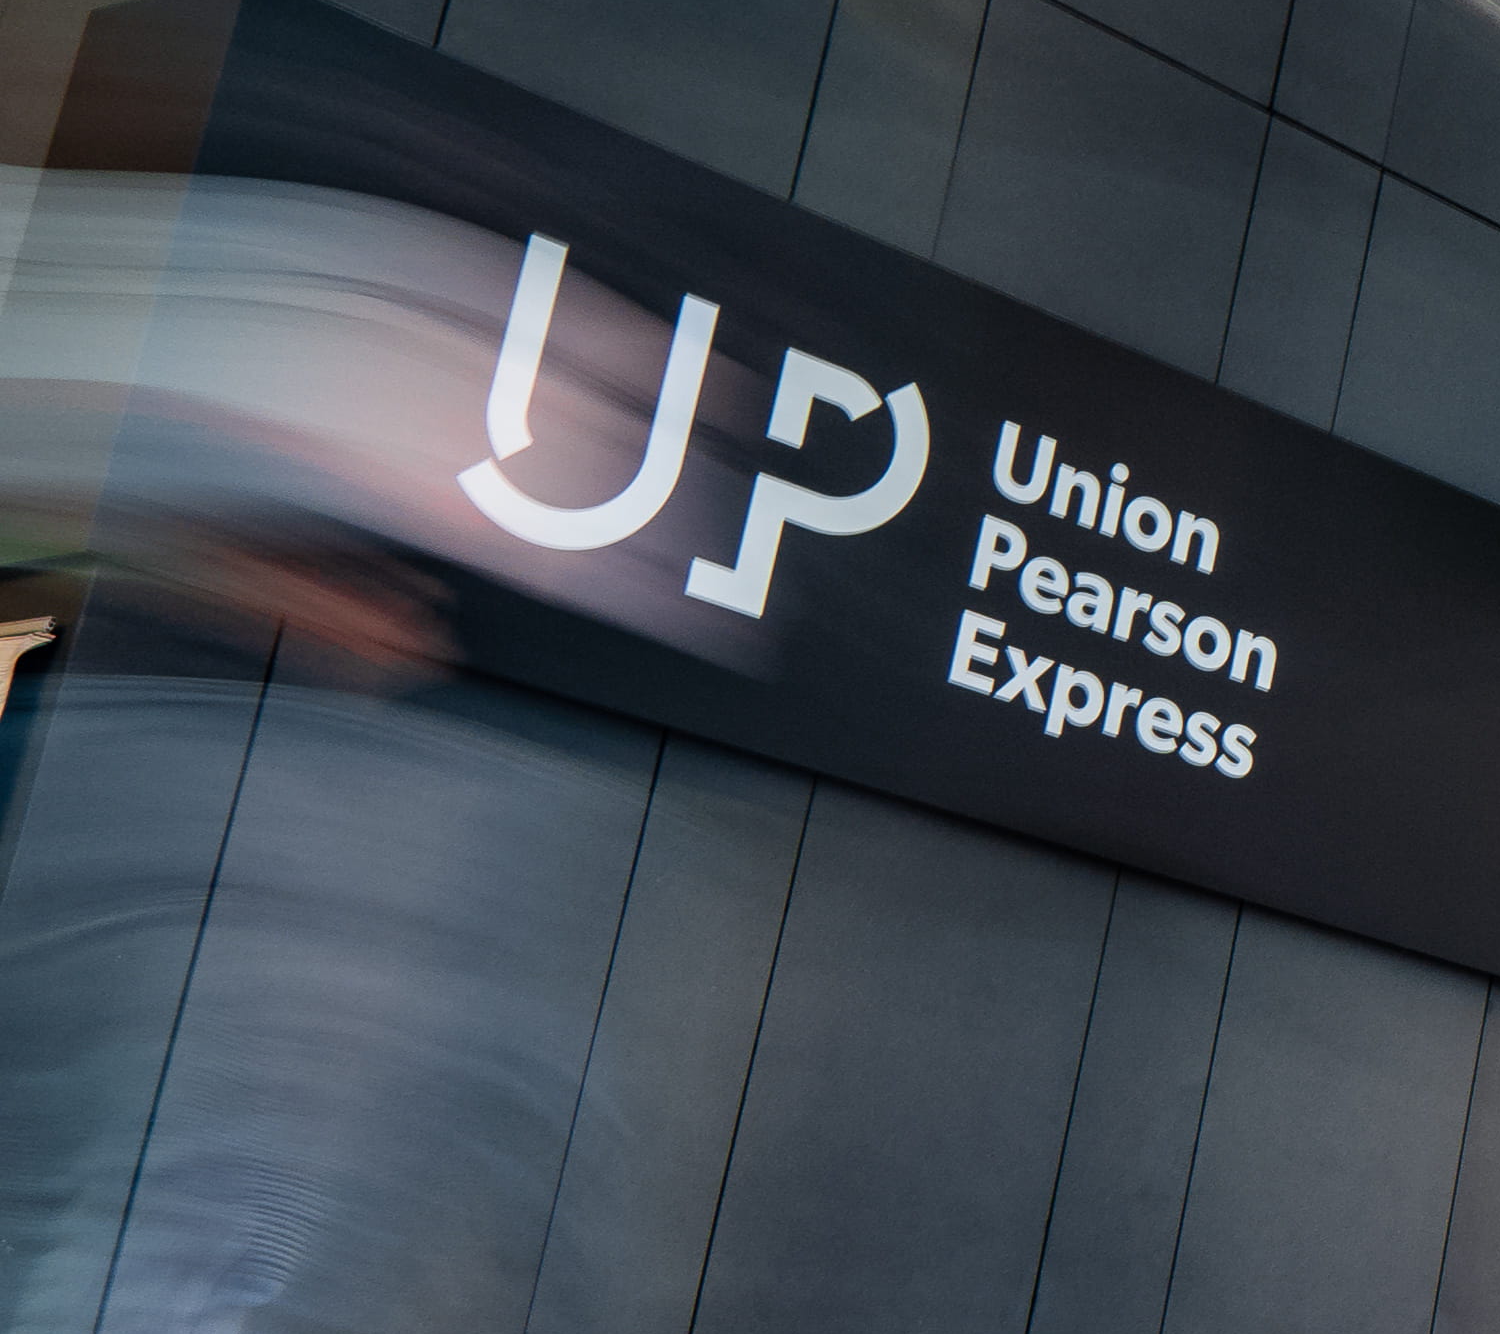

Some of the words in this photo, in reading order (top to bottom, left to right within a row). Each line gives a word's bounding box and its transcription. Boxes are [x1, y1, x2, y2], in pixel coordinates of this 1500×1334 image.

[456, 231, 931, 619] UP
[991, 420, 1222, 576] Union
[968, 514, 1278, 693] Pearson
[946, 609, 1259, 780] Express
